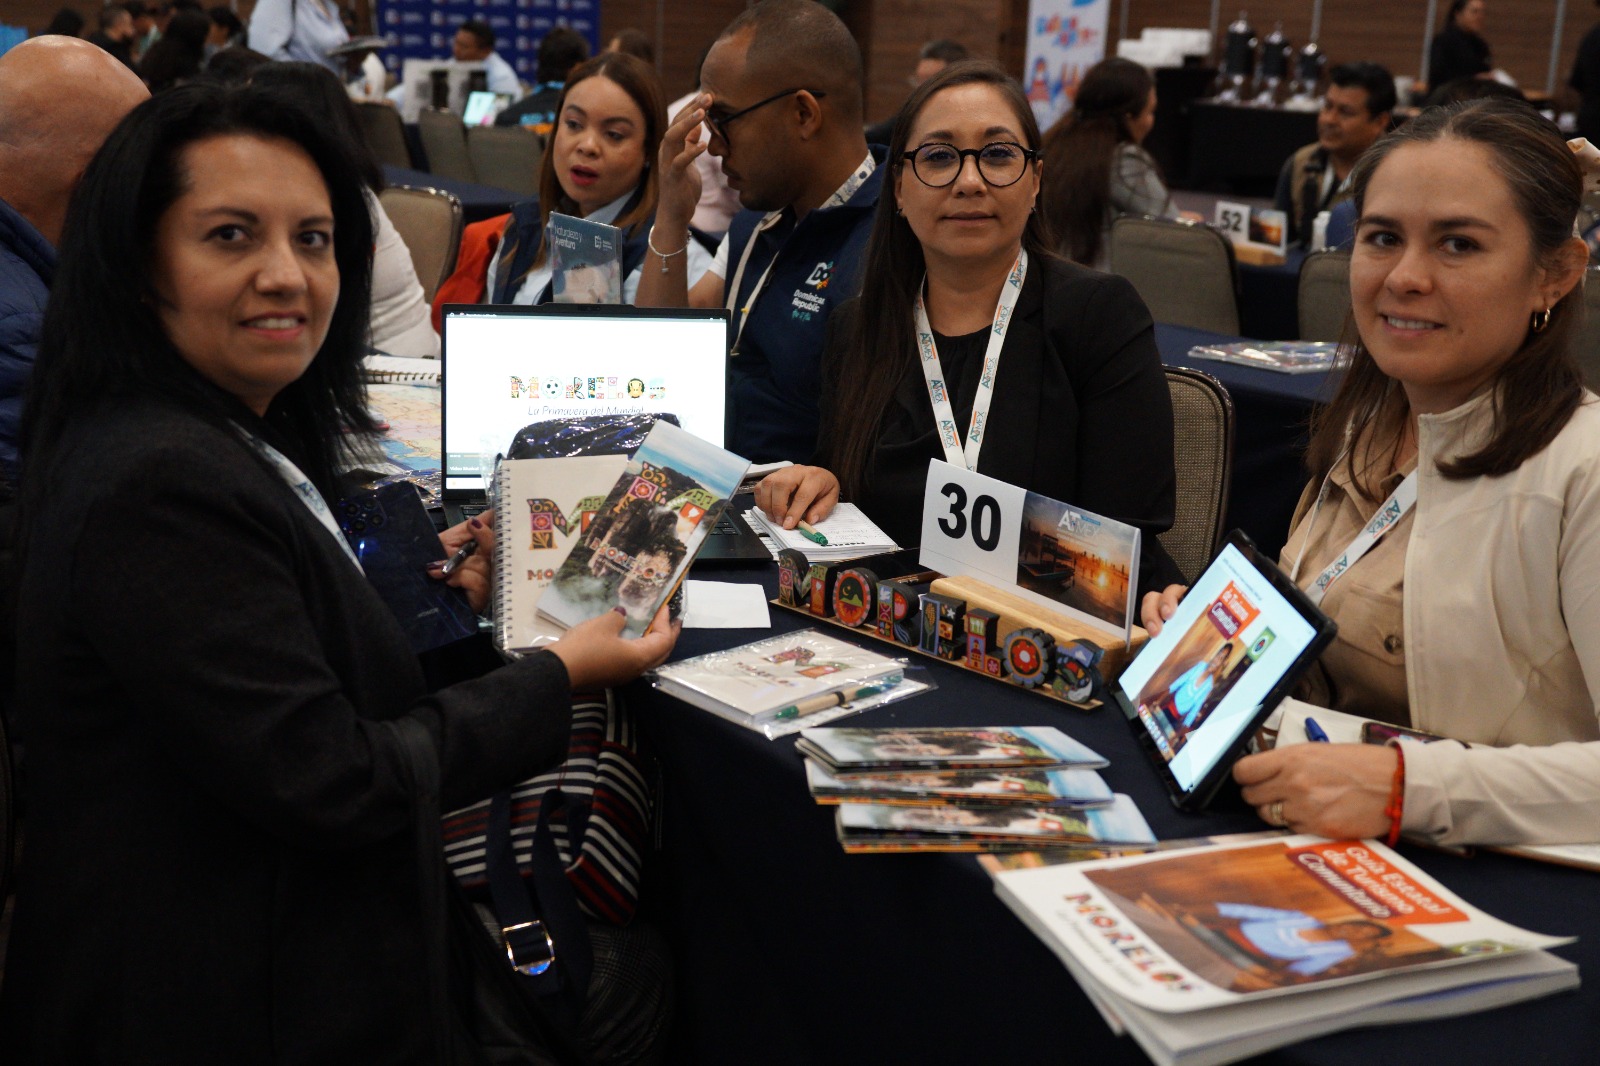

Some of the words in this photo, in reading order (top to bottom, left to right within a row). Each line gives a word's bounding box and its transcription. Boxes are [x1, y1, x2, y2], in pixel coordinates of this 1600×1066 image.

[1220, 210, 1242, 232] 52
[792, 297, 820, 313] Republic
[509, 376, 666, 400] MORELOS
[528, 406, 540, 416] La
[542, 405, 588, 416] Primavera
[590, 405, 604, 416] del
[606, 406, 644, 416] Mundial
[936, 482, 1002, 552] 30
[777, 548, 1105, 702] MORELOS
[1298, 853, 1391, 918] Comunitario
[1322, 850, 1349, 867] de
[1347, 865, 1415, 914] Turismo
[1381, 872, 1452, 914] Estatal
